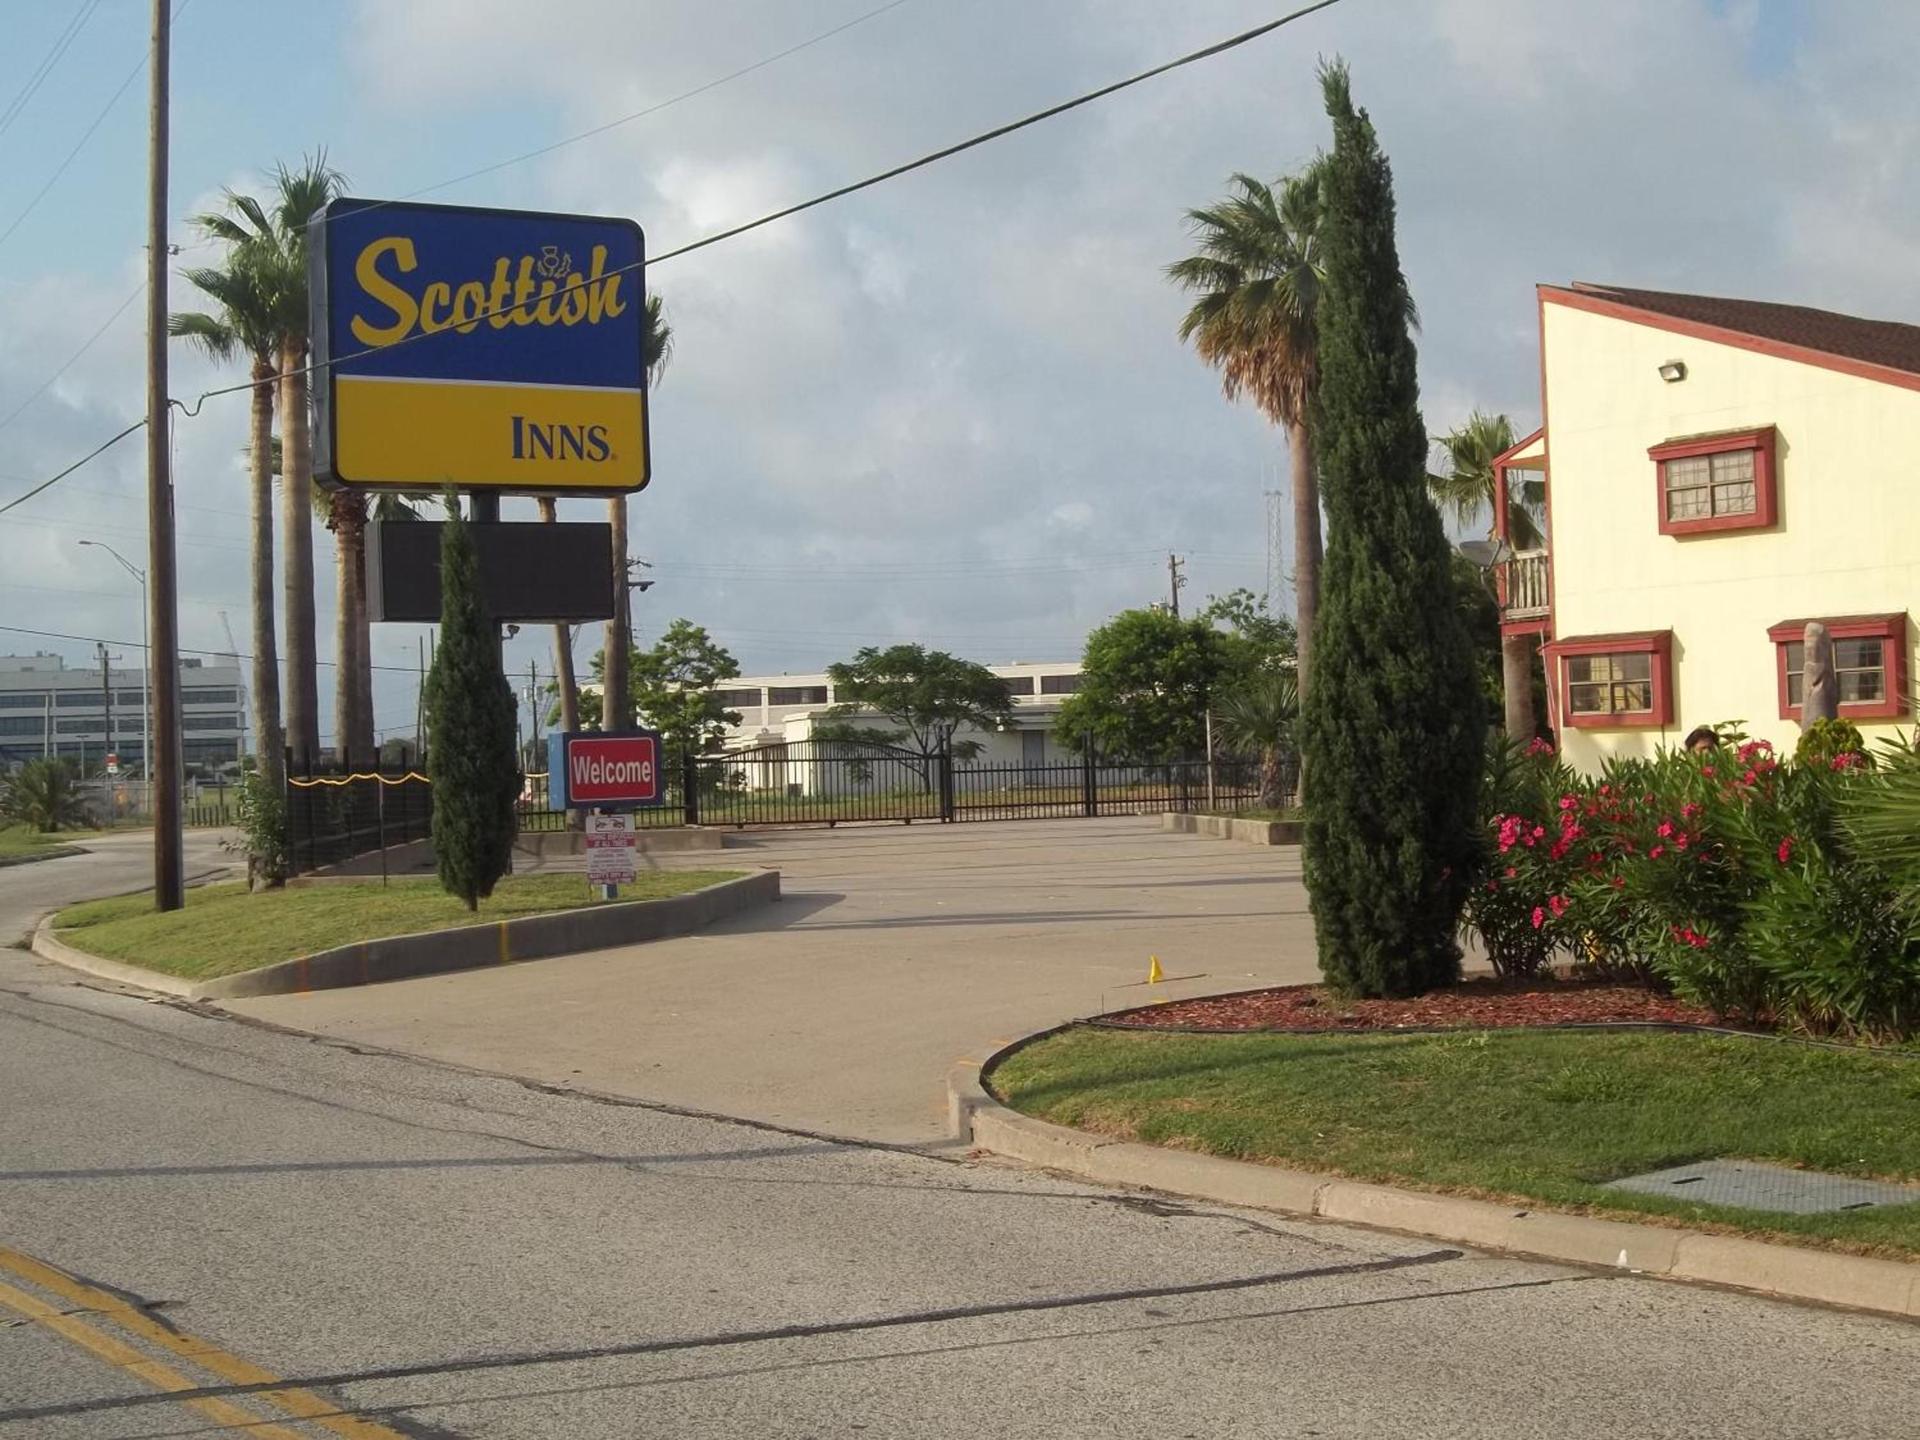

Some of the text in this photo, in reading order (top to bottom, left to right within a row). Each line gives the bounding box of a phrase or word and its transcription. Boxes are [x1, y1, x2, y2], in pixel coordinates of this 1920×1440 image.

[351, 236, 626, 346] Scottish
[511, 415, 611, 462] INNS
[573, 755, 652, 785] Welcome
